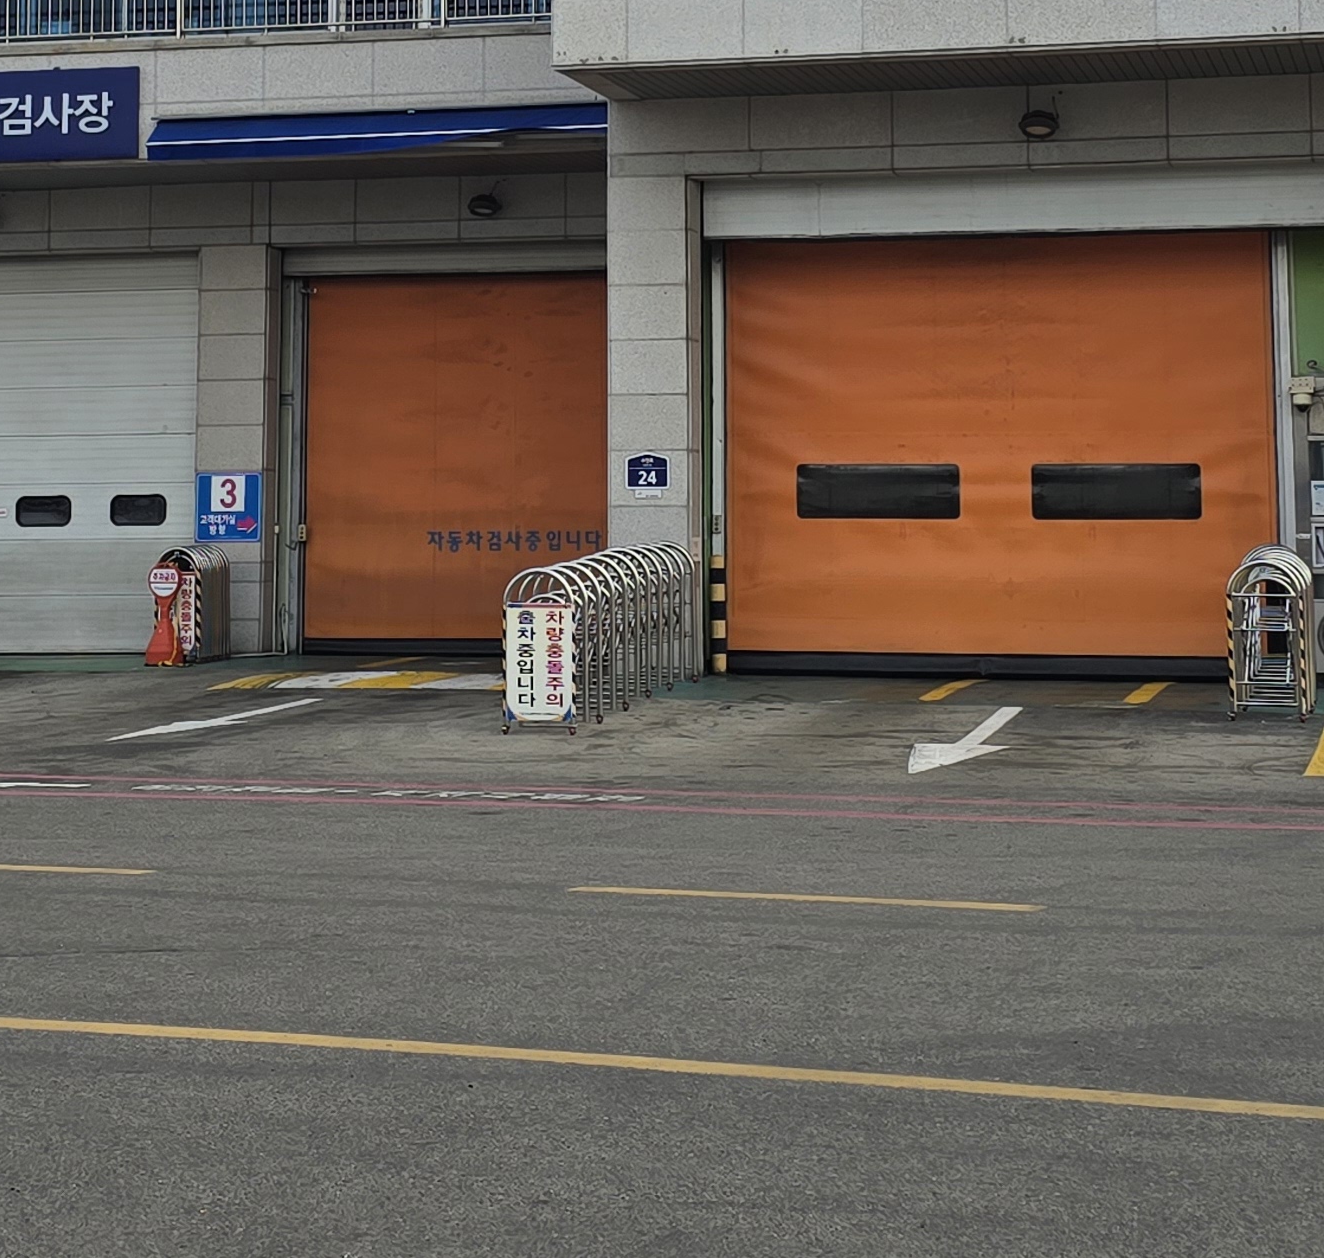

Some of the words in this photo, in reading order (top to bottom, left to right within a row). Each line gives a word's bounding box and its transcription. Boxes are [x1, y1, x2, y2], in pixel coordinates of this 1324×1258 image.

[220, 478, 237, 509] 3
[638, 471, 657, 485] 24
[426, 530, 603, 553] 자동차검사중입니다
[516, 610, 536, 708] 출차중입니다
[545, 610, 565, 708] 차량충돌주의
